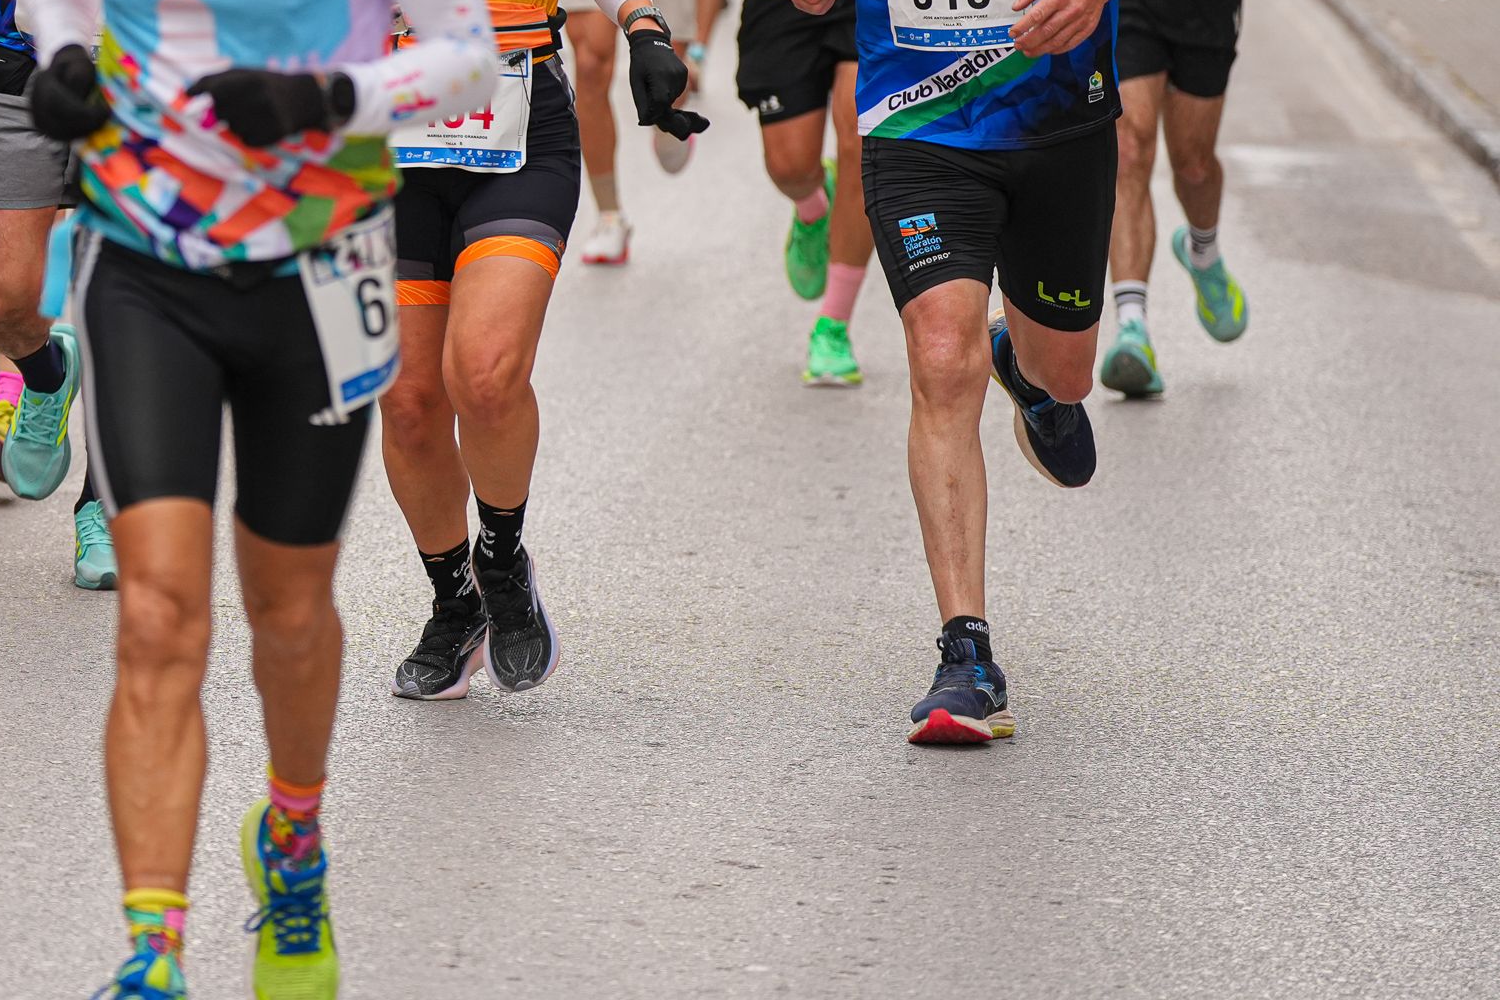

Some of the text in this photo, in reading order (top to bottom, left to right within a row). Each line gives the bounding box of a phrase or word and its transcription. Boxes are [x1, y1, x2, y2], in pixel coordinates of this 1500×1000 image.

[887, 84, 933, 111] Club
[903, 233, 924, 245] Club
[905, 236, 942, 251] Maratón
[907, 244, 941, 259] Lucena
